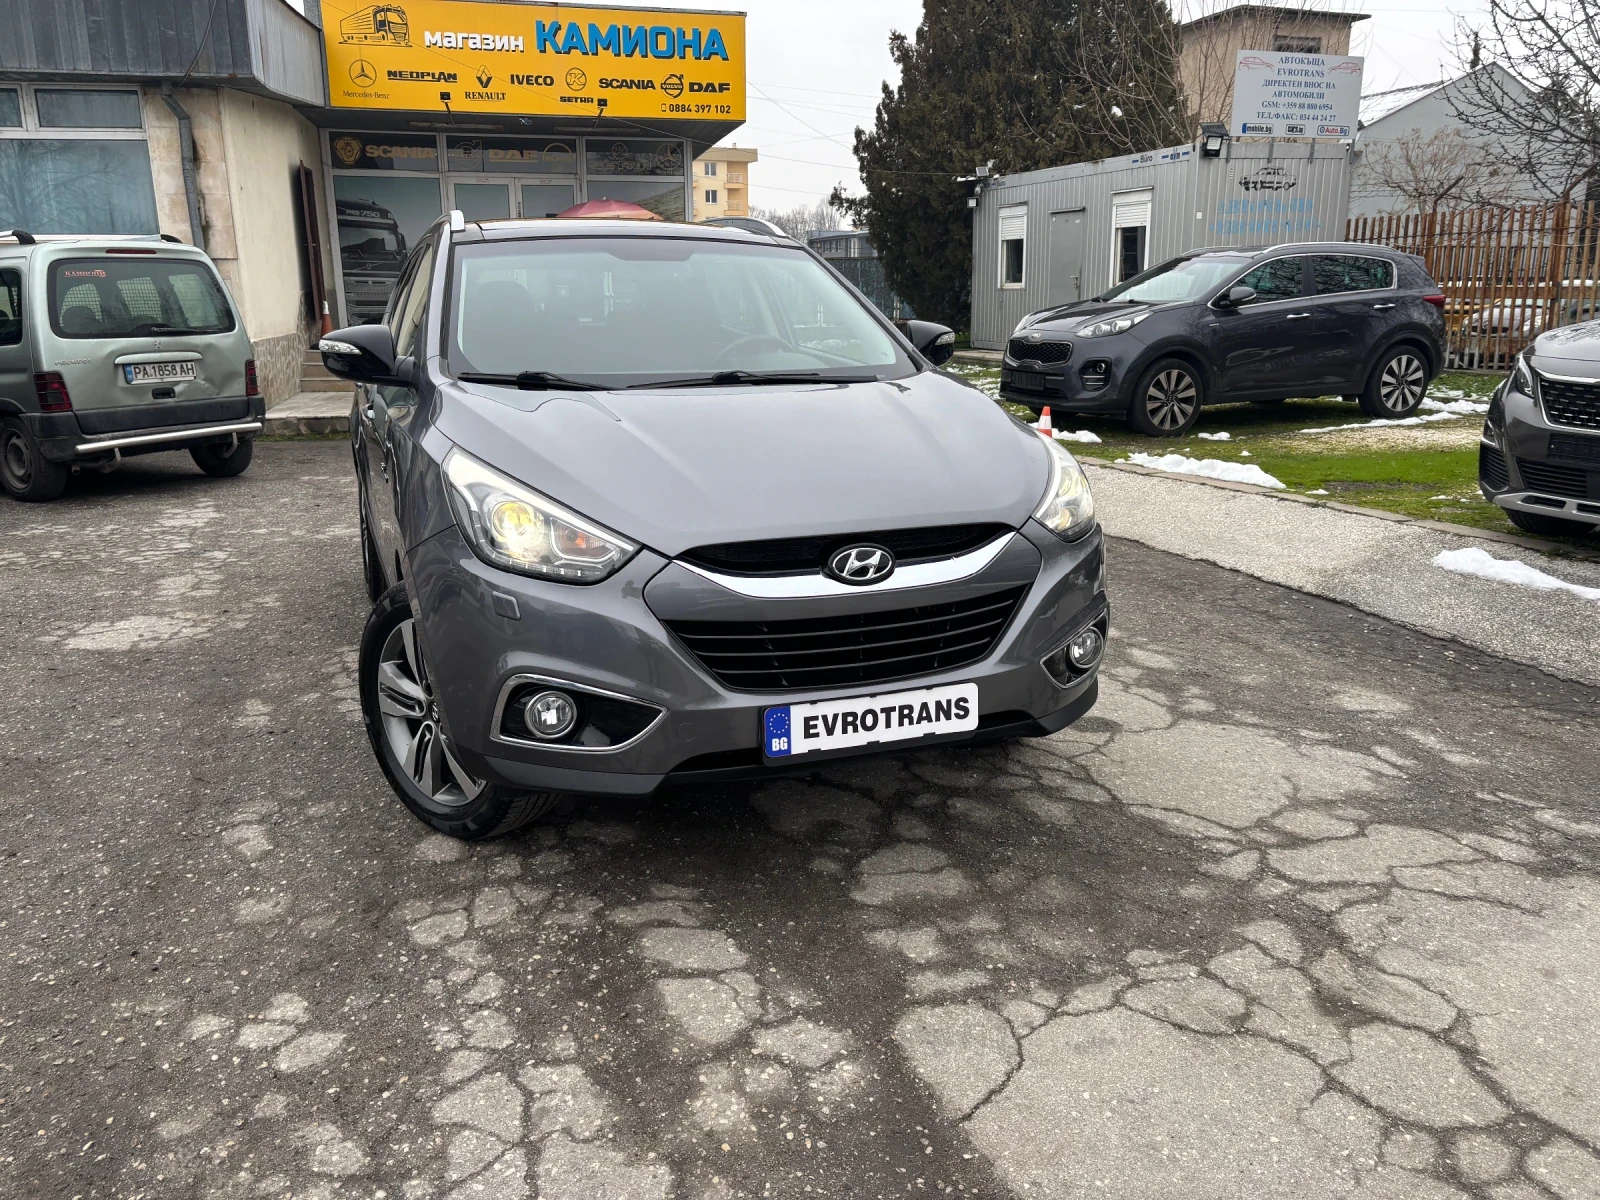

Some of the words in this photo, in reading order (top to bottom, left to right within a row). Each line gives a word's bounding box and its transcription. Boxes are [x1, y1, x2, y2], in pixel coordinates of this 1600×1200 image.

[424, 30, 524, 52] магазин
[535, 20, 729, 61] КАМИОНА
[1279, 56, 1325, 66] АВТОКЪЩА
[387, 70, 458, 83] NEOPLAN
[1277, 68, 1325, 78] EVROTRANS
[510, 74, 555, 87] IVECO
[598, 77, 656, 90] SCANIA
[1262, 79, 1302, 88] ДИРЕКТЕН
[1304, 80, 1324, 89] ВНОС
[1325, 82, 1336, 90] НА
[688, 82, 731, 94] DAF
[343, 90, 390, 99] Mercedes-Benz
[464, 91, 507, 101] RENAULT
[1272, 90, 1325, 100] АВТОМОБИЛИ
[559, 96, 594, 104] SETRA
[1261, 100, 1281, 109] GSM:
[1298, 102, 1306, 110] 88
[669, 104, 692, 113] 0884
[694, 104, 712, 113] 397
[714, 105, 731, 114] 102
[1299, 113, 1310, 121] 034
[1246, 124, 1272, 133] mobile.bg
[365, 144, 437, 159] SCANIA
[361, 210, 380, 218] 750
[151, 364, 178, 378] 1858
[180, 363, 195, 376] AH
[803, 697, 970, 740] EVROTRANS
[771, 737, 788, 751] BG
